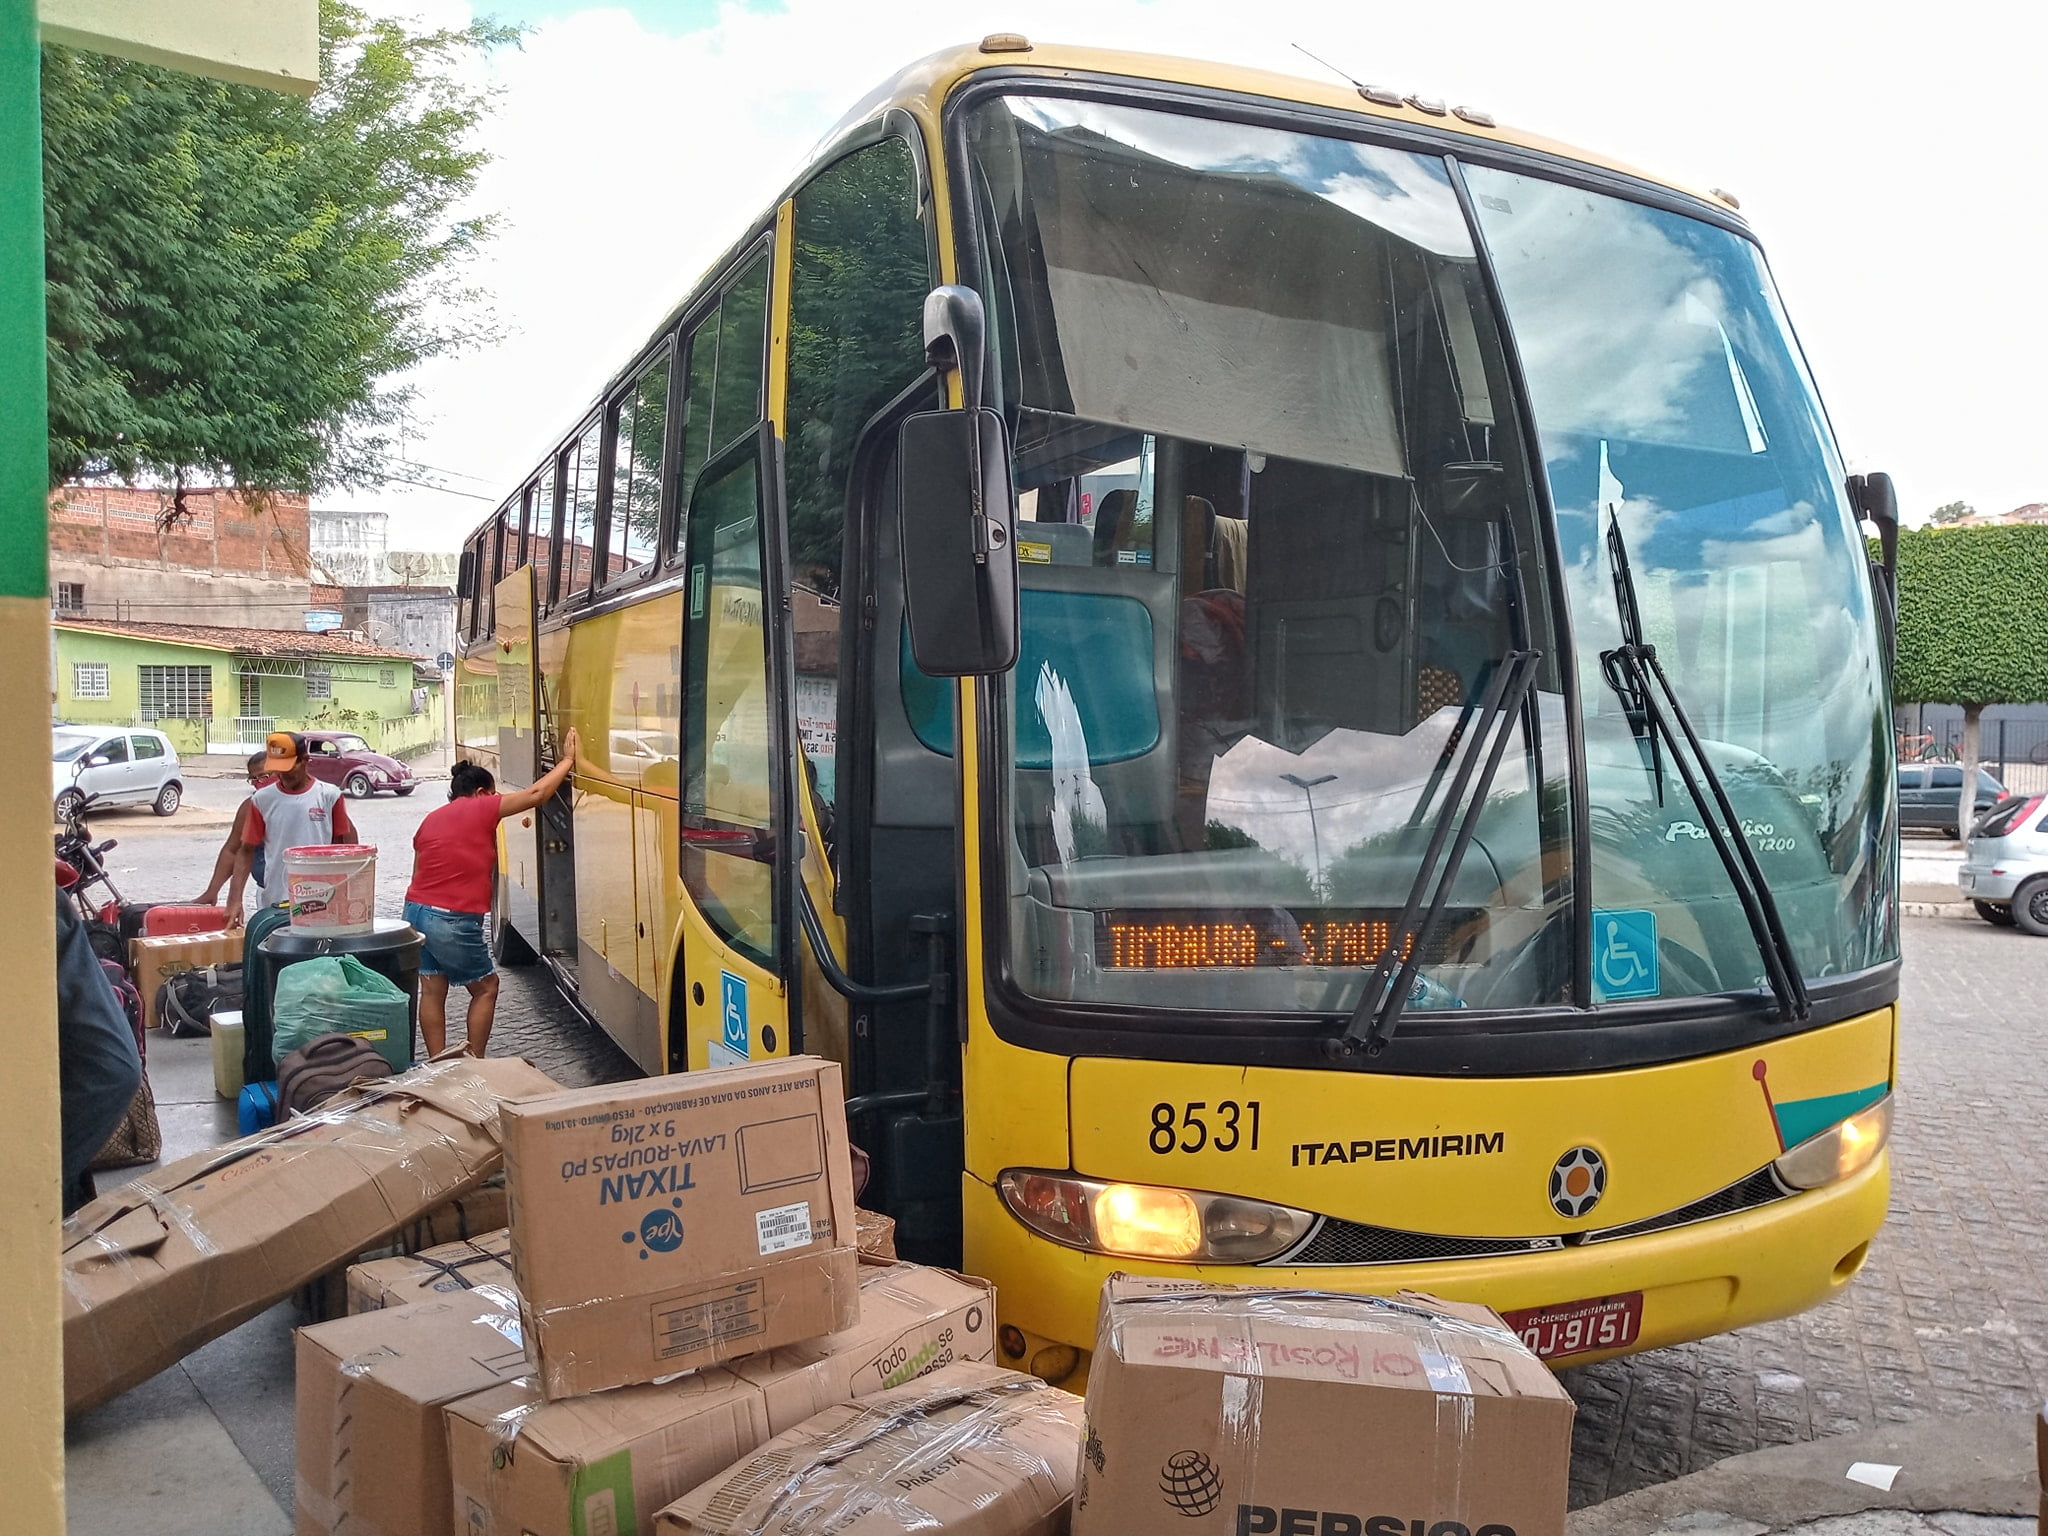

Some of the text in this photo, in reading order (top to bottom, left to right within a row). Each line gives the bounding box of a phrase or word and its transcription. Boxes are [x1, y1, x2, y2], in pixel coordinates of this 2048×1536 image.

[1758, 837, 1796, 851] 1200
[747, 1086, 770, 1098] ANOS
[771, 1084, 777, 1093] 2
[793, 1078, 816, 1090] USAR
[699, 1096, 710, 1107] DE
[711, 1092, 733, 1104] DATA
[734, 1090, 746, 1100] DA
[612, 1109, 635, 1121] PESO
[644, 1098, 698, 1116] FABRICAÇÃO
[611, 1120, 676, 1146] 9 x 2kg
[1148, 1101, 1260, 1155] 8531
[1292, 1132, 1505, 1167] ITAPEMIRIM
[560, 1133, 727, 1183] LAVA-ROUPAS PÓ
[599, 1162, 697, 1206] TIXAN
[938, 1327, 954, 1348] se
[872, 1346, 907, 1379] Todo
